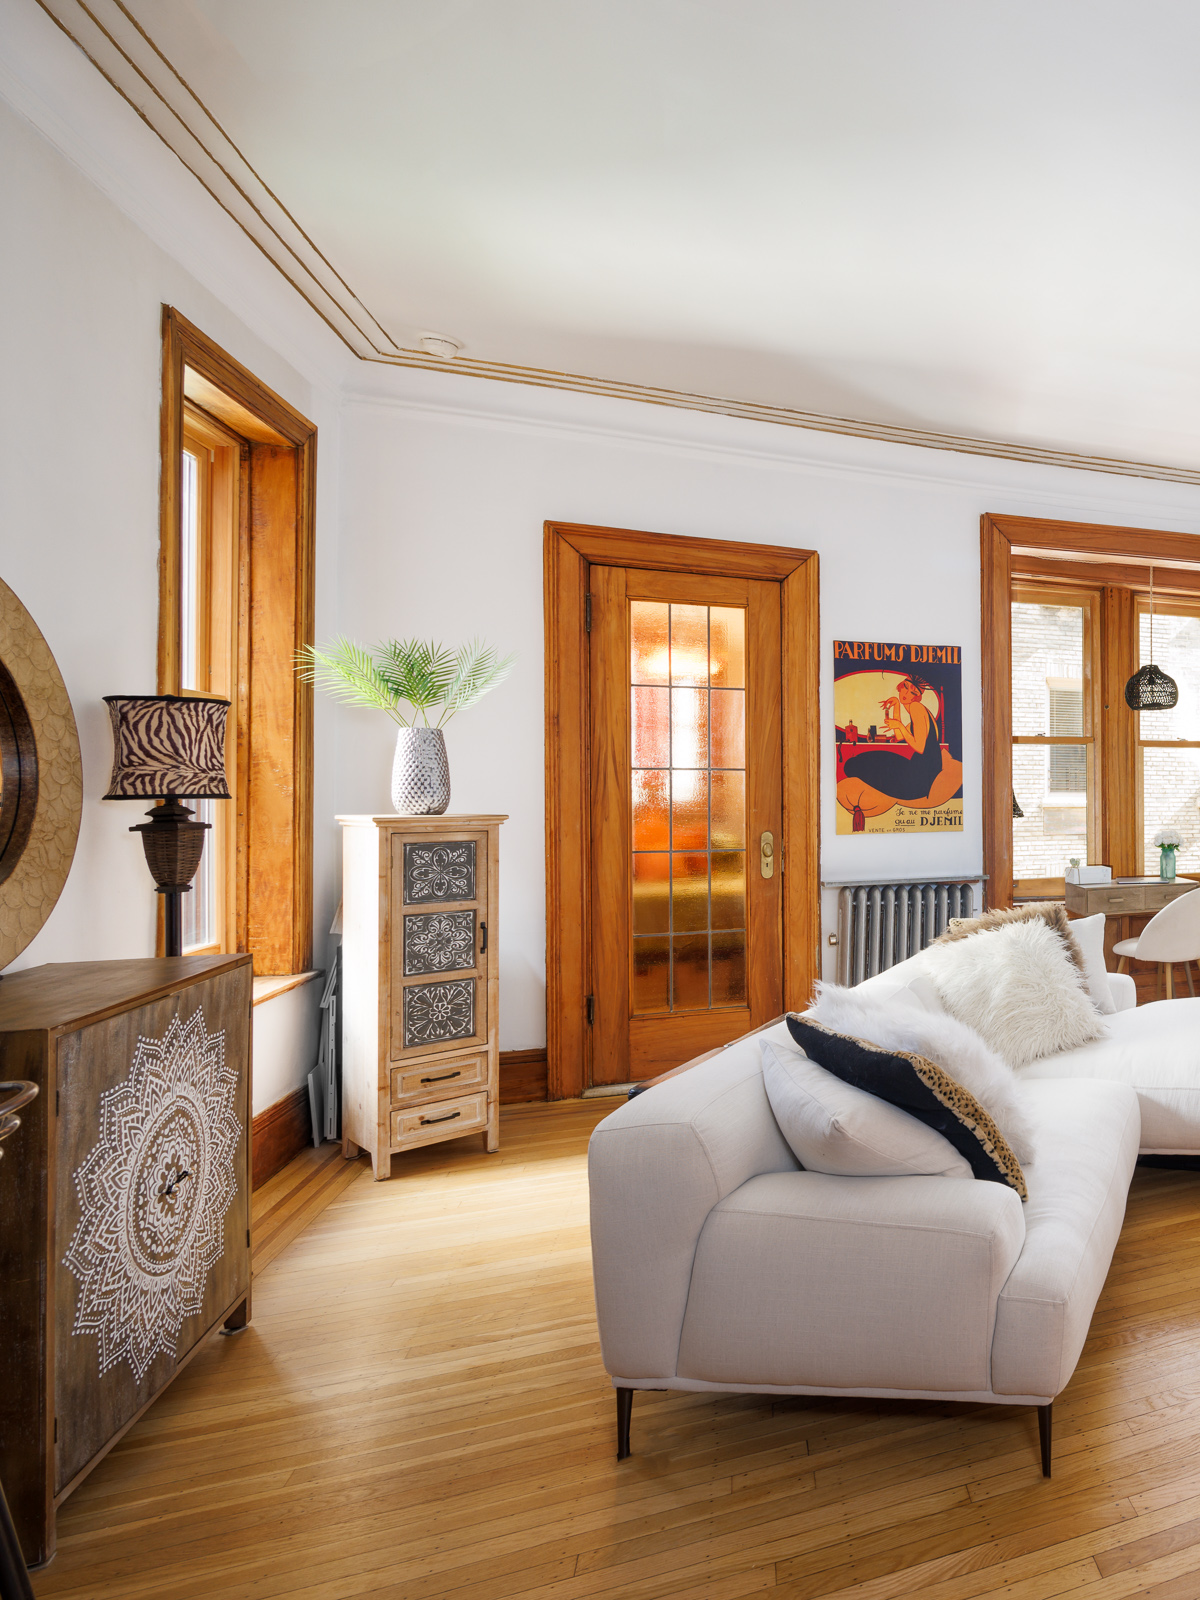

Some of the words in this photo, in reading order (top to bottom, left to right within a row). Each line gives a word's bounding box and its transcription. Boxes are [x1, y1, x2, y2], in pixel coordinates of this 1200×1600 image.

[834, 641, 908, 662] PARFUMS
[910, 645, 962, 664] DJEMIL
[934, 808, 963, 817] parfume
[920, 816, 963, 826] DJEMIL
